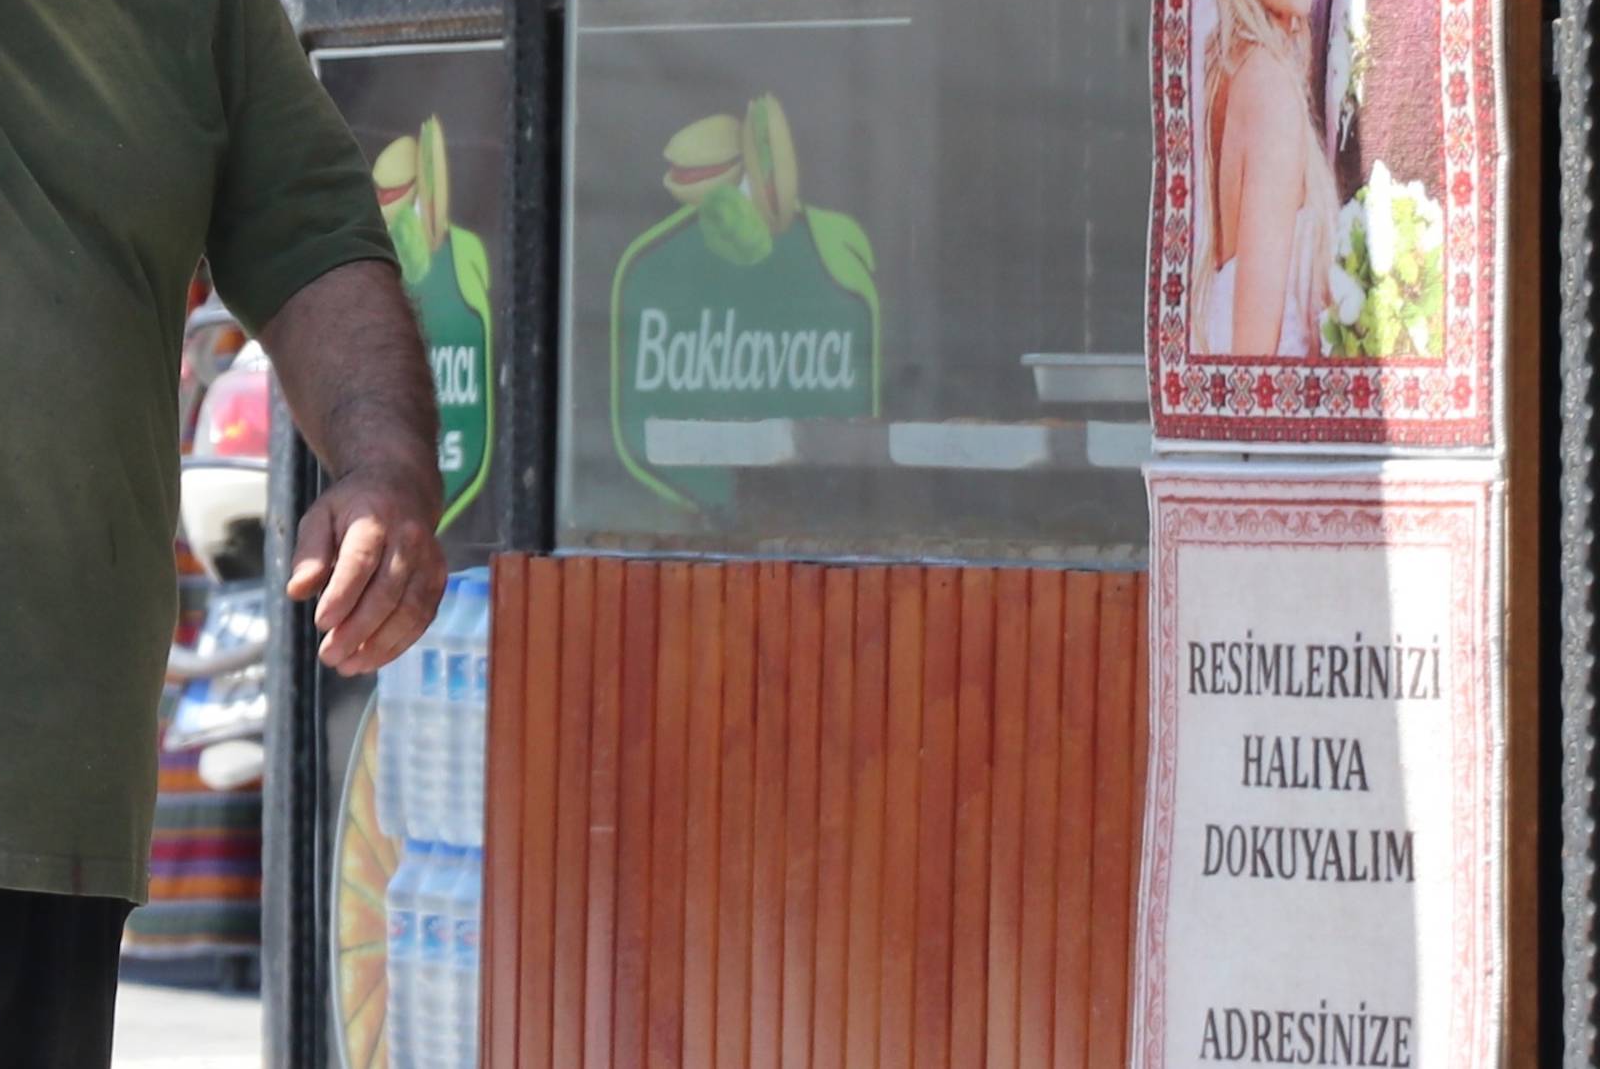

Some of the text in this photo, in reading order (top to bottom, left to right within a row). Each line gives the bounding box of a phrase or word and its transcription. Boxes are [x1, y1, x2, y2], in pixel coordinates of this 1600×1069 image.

[635, 307, 856, 392] Baklavacı
[1188, 630, 1442, 701] RESİMLERİNİZİ
[1241, 735, 1370, 793] HALIYA
[1201, 822, 1417, 884] DOKUYALIM
[1200, 999, 1412, 1068] ADRESİNİZE
